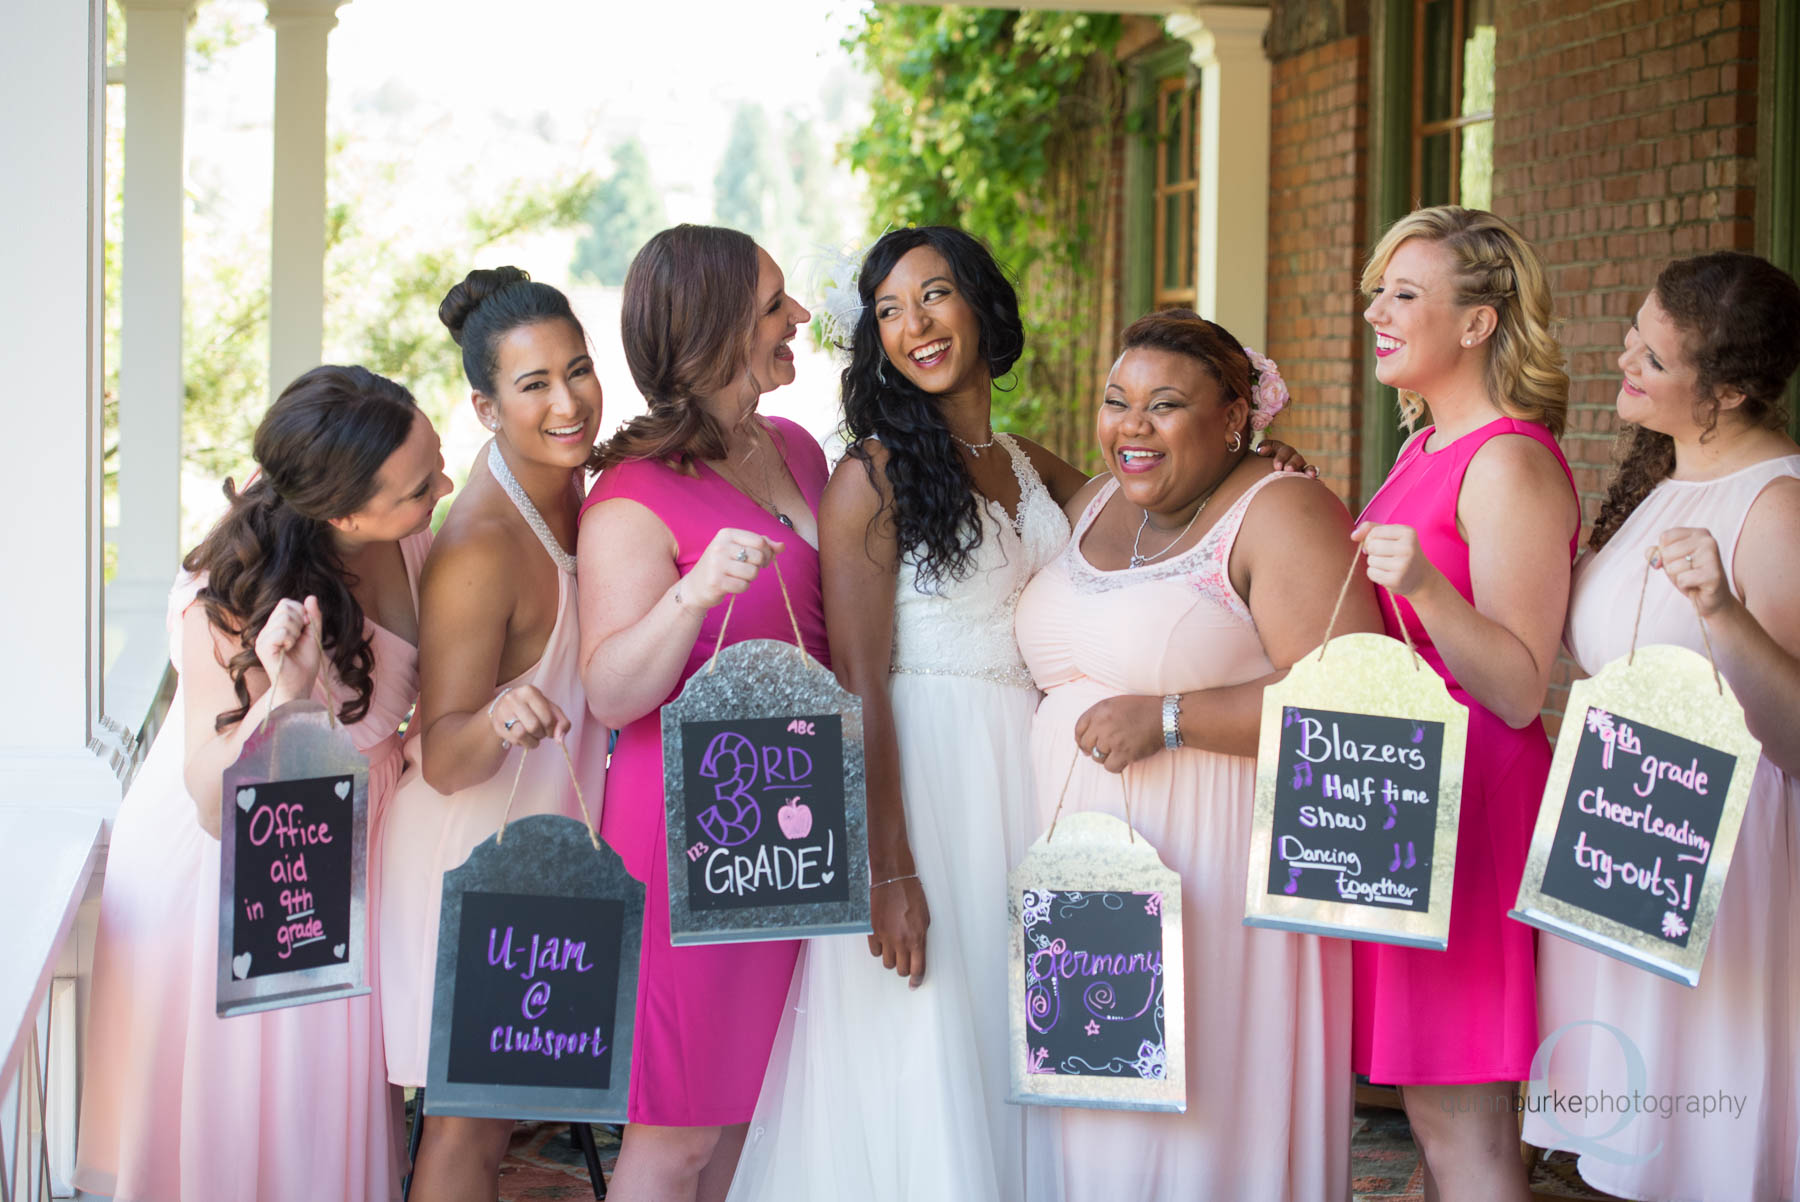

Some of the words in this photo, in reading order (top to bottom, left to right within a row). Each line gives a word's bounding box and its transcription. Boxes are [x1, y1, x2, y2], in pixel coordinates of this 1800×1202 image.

[787, 719, 816, 736] ABC
[1295, 717, 1426, 770] Blazers
[1599, 722, 1642, 770] 9th
[1633, 755, 1709, 797] grade
[1322, 774, 1375, 806] Half
[1381, 778, 1430, 805] time
[249, 803, 333, 848] Office
[270, 853, 307, 884] aid
[687, 841, 710, 862] 123
[705, 829, 835, 896] GRADE!
[1278, 835, 1362, 876] Dancing
[1573, 831, 1693, 910] try-outs!
[244, 898, 264, 921] in
[280, 888, 313, 915] 9th
[1335, 871, 1418, 902] together
[277, 917, 324, 959] grade
[521, 981, 551, 1020] @
